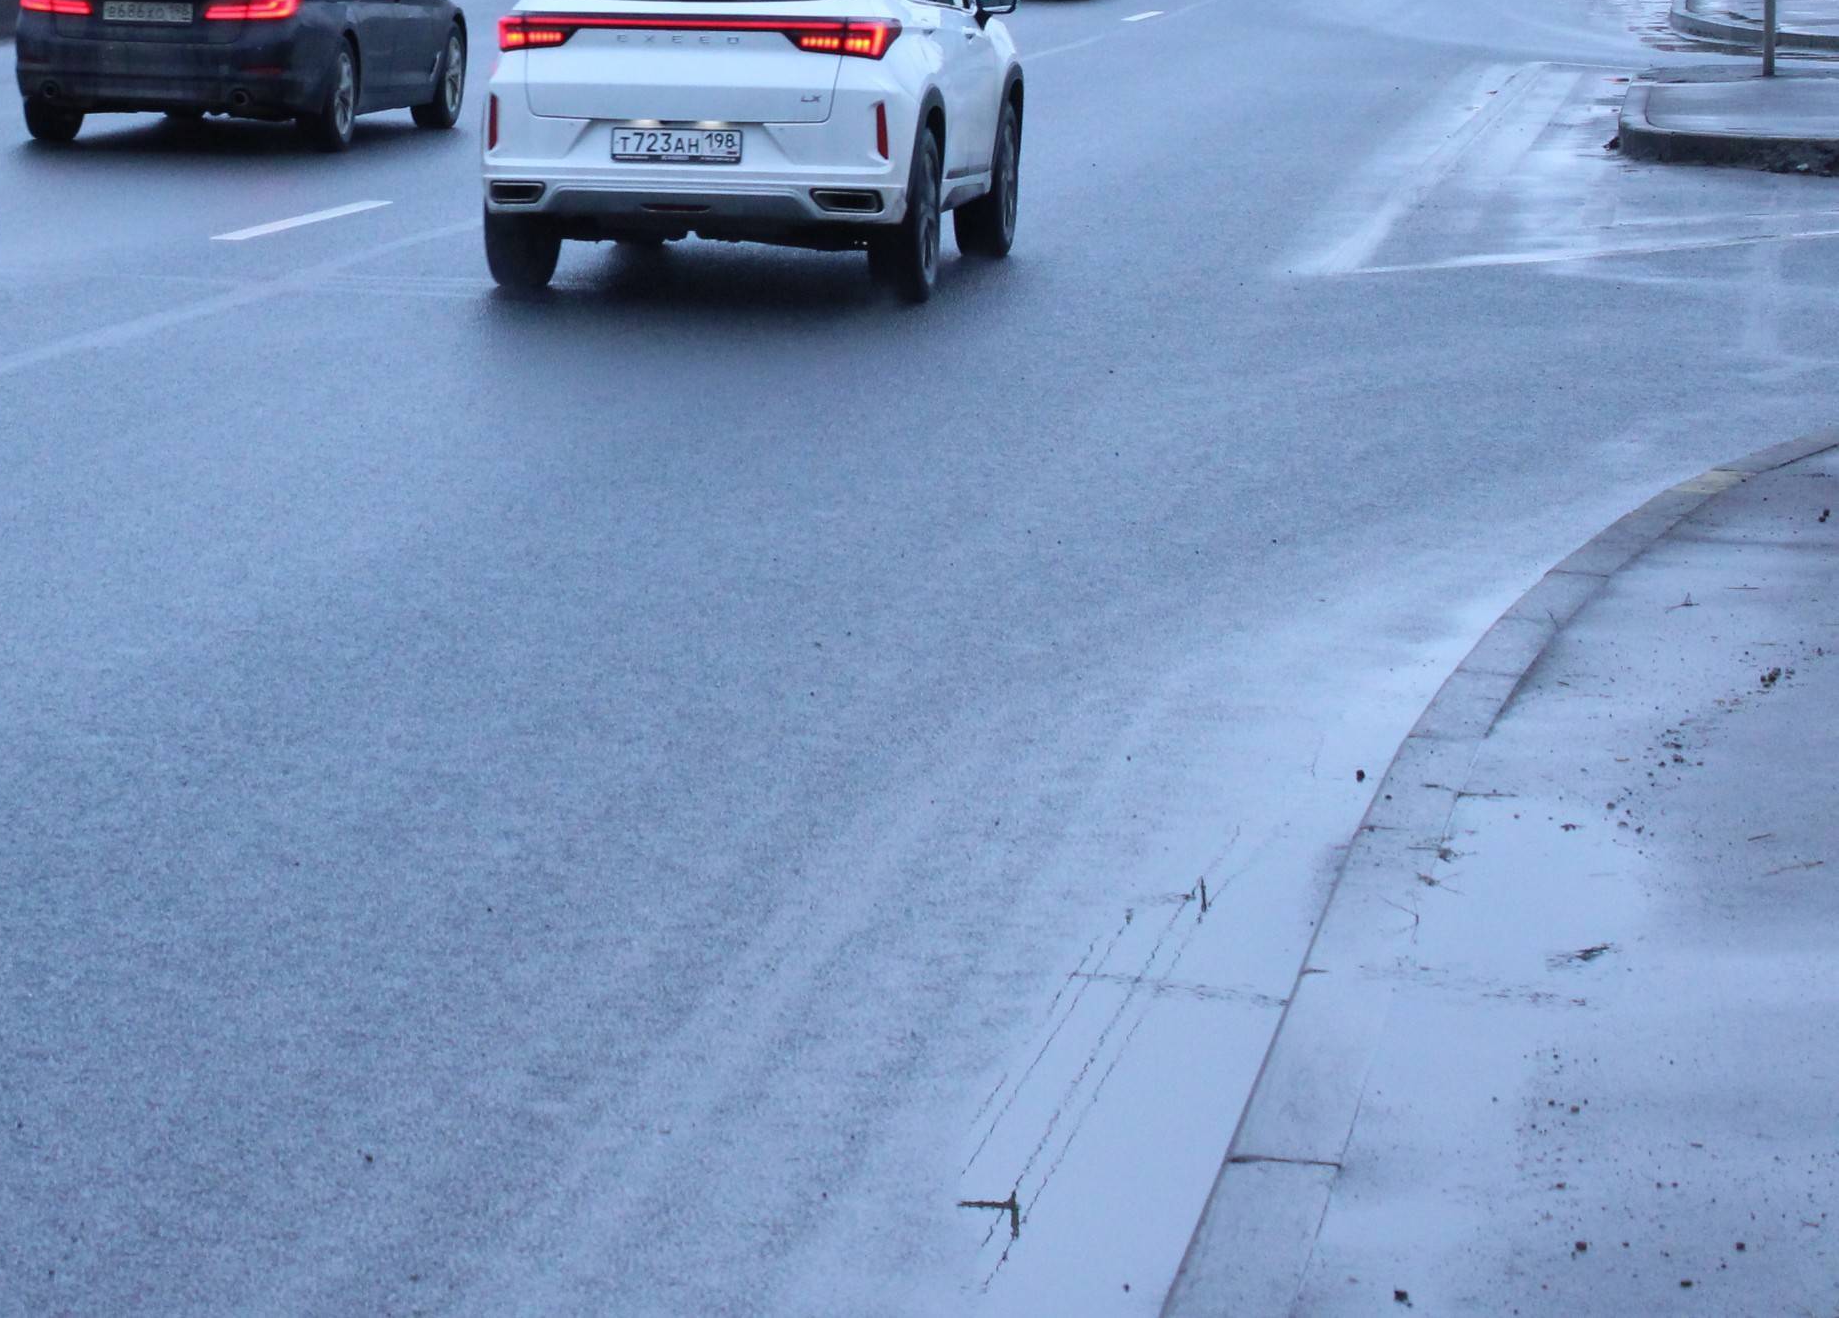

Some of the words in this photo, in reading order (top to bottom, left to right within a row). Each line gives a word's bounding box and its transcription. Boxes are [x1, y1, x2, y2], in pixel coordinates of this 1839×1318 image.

[617, 34, 739, 45] EXEED
[800, 94, 821, 103] LX
[620, 132, 699, 153] Т723АН
[705, 132, 736, 149] 198
